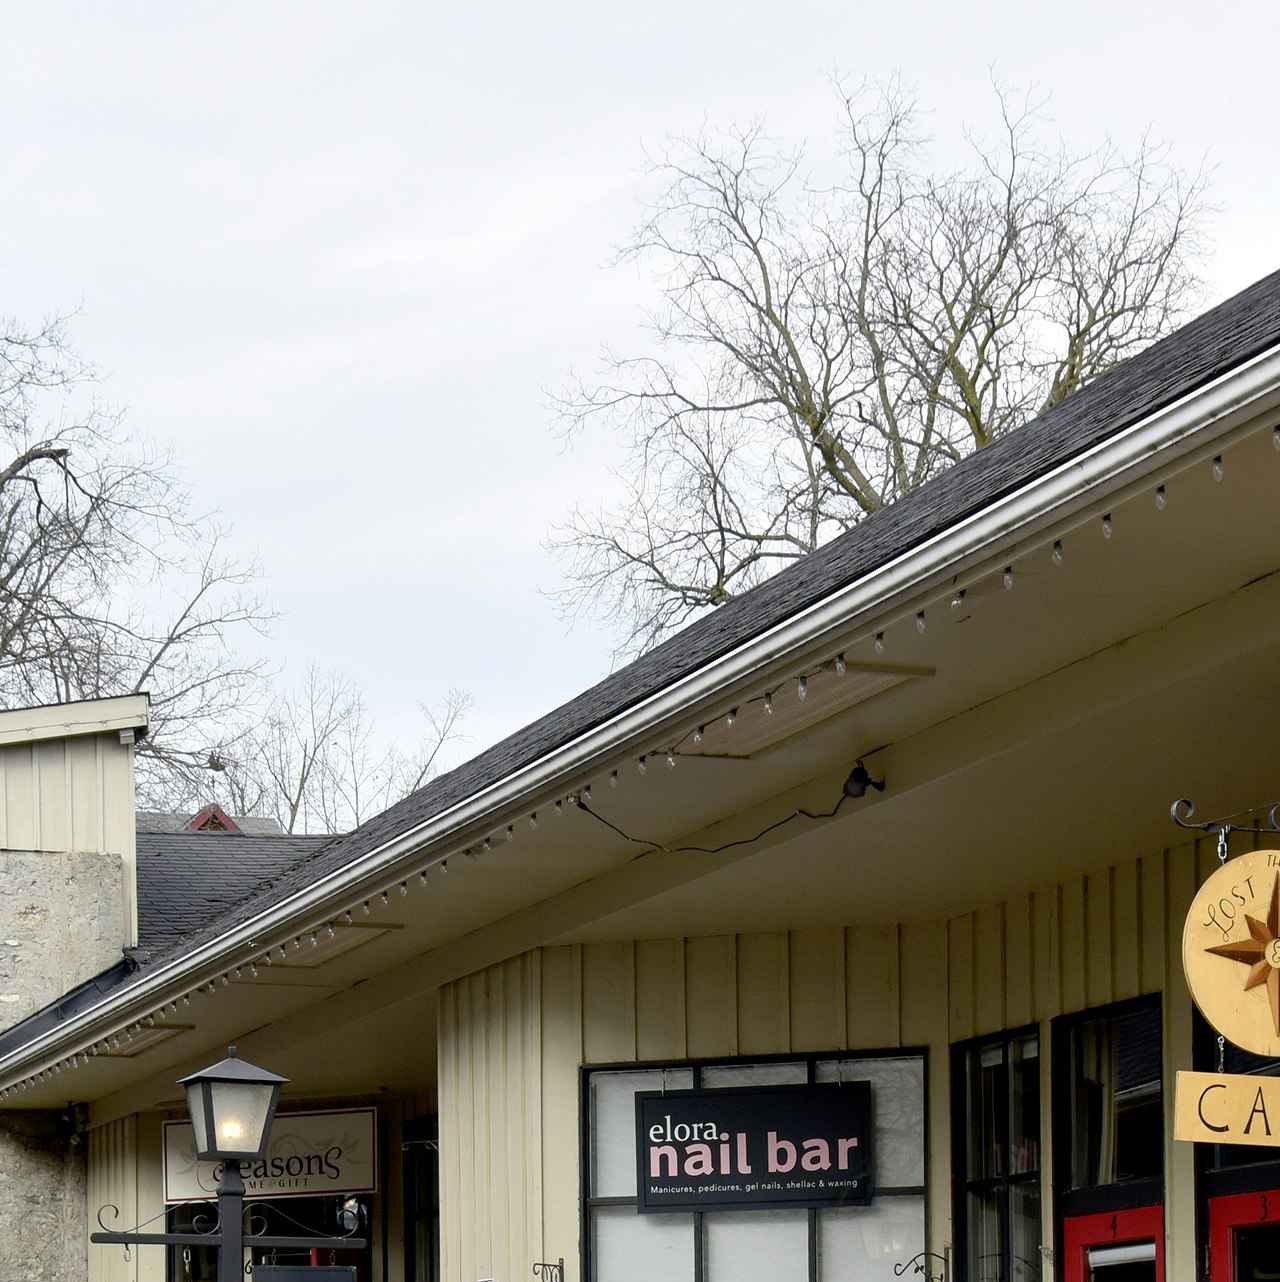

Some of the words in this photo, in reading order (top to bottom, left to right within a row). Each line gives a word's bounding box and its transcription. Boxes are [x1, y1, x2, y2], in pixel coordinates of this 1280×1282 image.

[1203, 875, 1257, 942] LOST
[649, 1116, 719, 1143] elora
[213, 1146, 342, 1182] easons
[650, 1132, 752, 1178] nail
[768, 1131, 859, 1174] bar
[279, 1178, 308, 1187] GIFT
[650, 1185, 696, 1195] Manicures,
[698, 1182, 743, 1194] pedicures,
[745, 1181, 759, 1193] gel
[761, 1181, 784, 1192] nails,
[786, 1179, 816, 1189] shellac
[819, 1179, 825, 1188] &
[827, 1178, 858, 1190] waxing
[1260, 1194, 1268, 1221] 3
